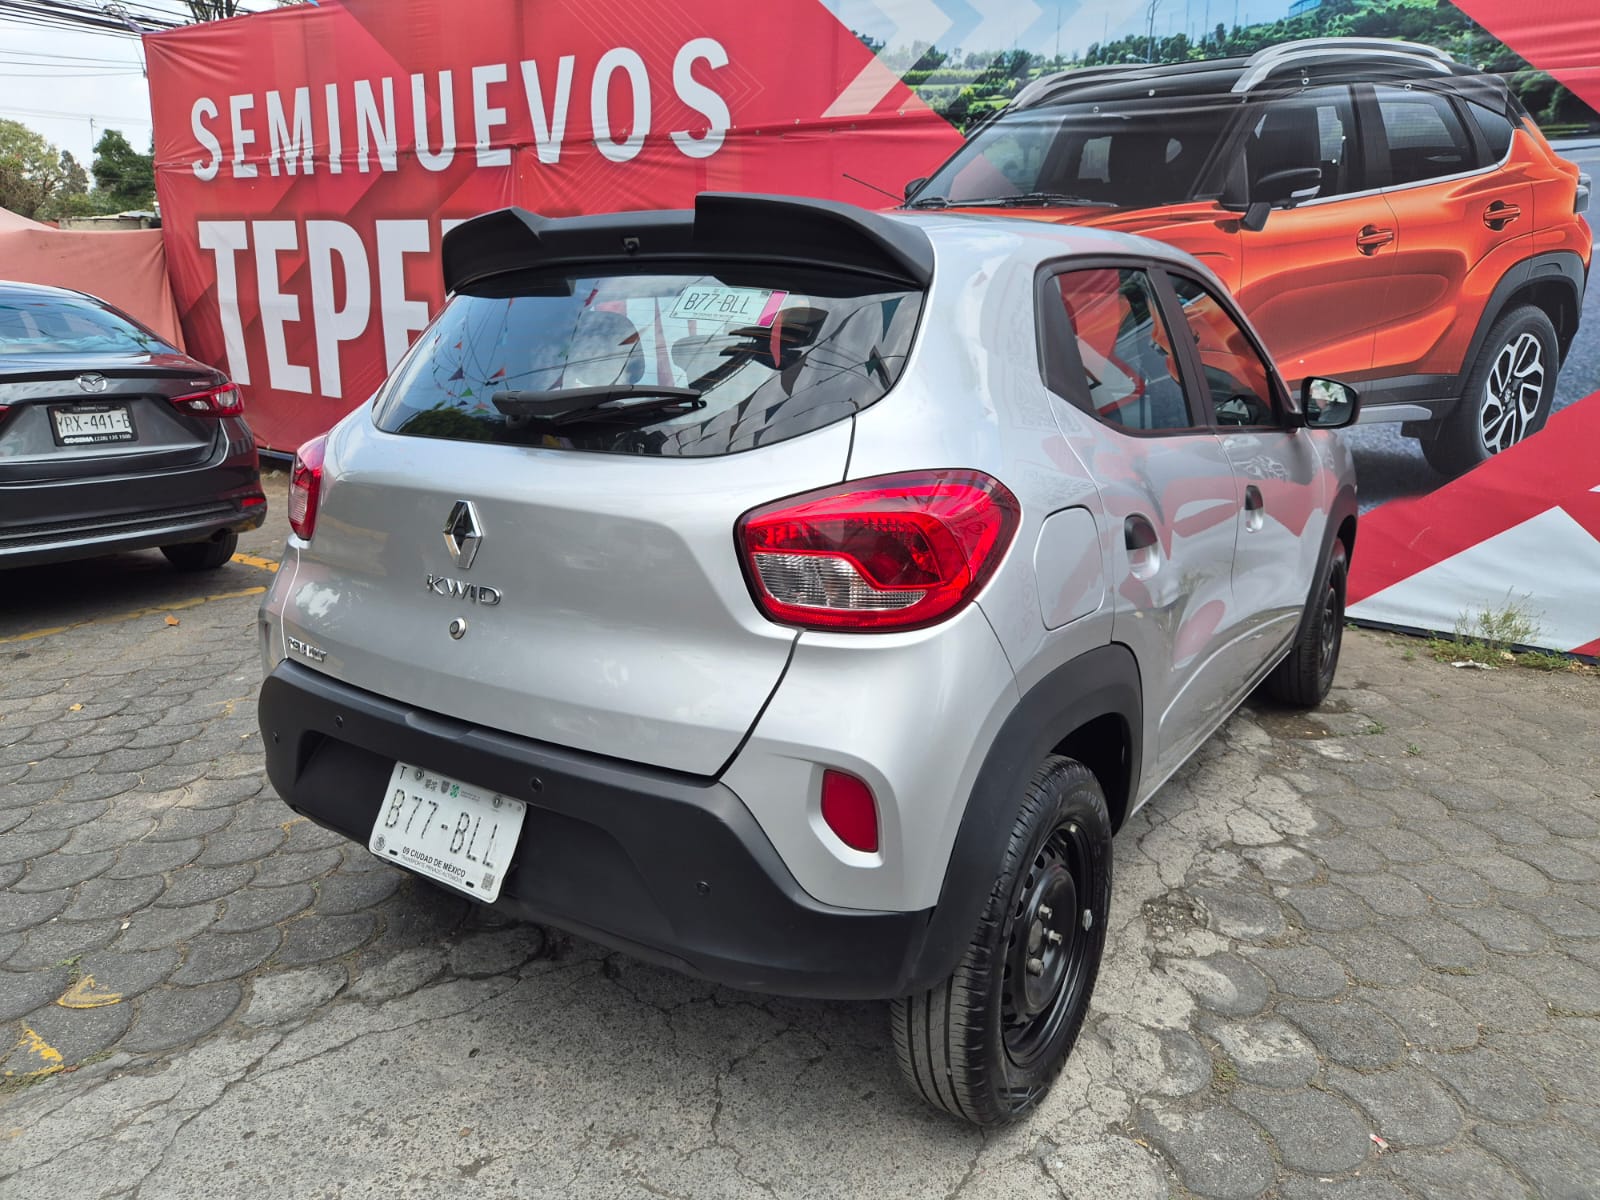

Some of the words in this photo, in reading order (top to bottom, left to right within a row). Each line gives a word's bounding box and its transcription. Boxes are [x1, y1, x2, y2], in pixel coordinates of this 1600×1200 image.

[191, 37, 731, 182] SEMINUEVOS
[197, 219, 468, 399] TEPE
[684, 293, 749, 315] B77-BLL
[426, 573, 501, 606] KWID
[385, 789, 498, 868] B77-BLL
[410, 849, 433, 864] CIUDAD
[433, 858, 443, 867] DE
